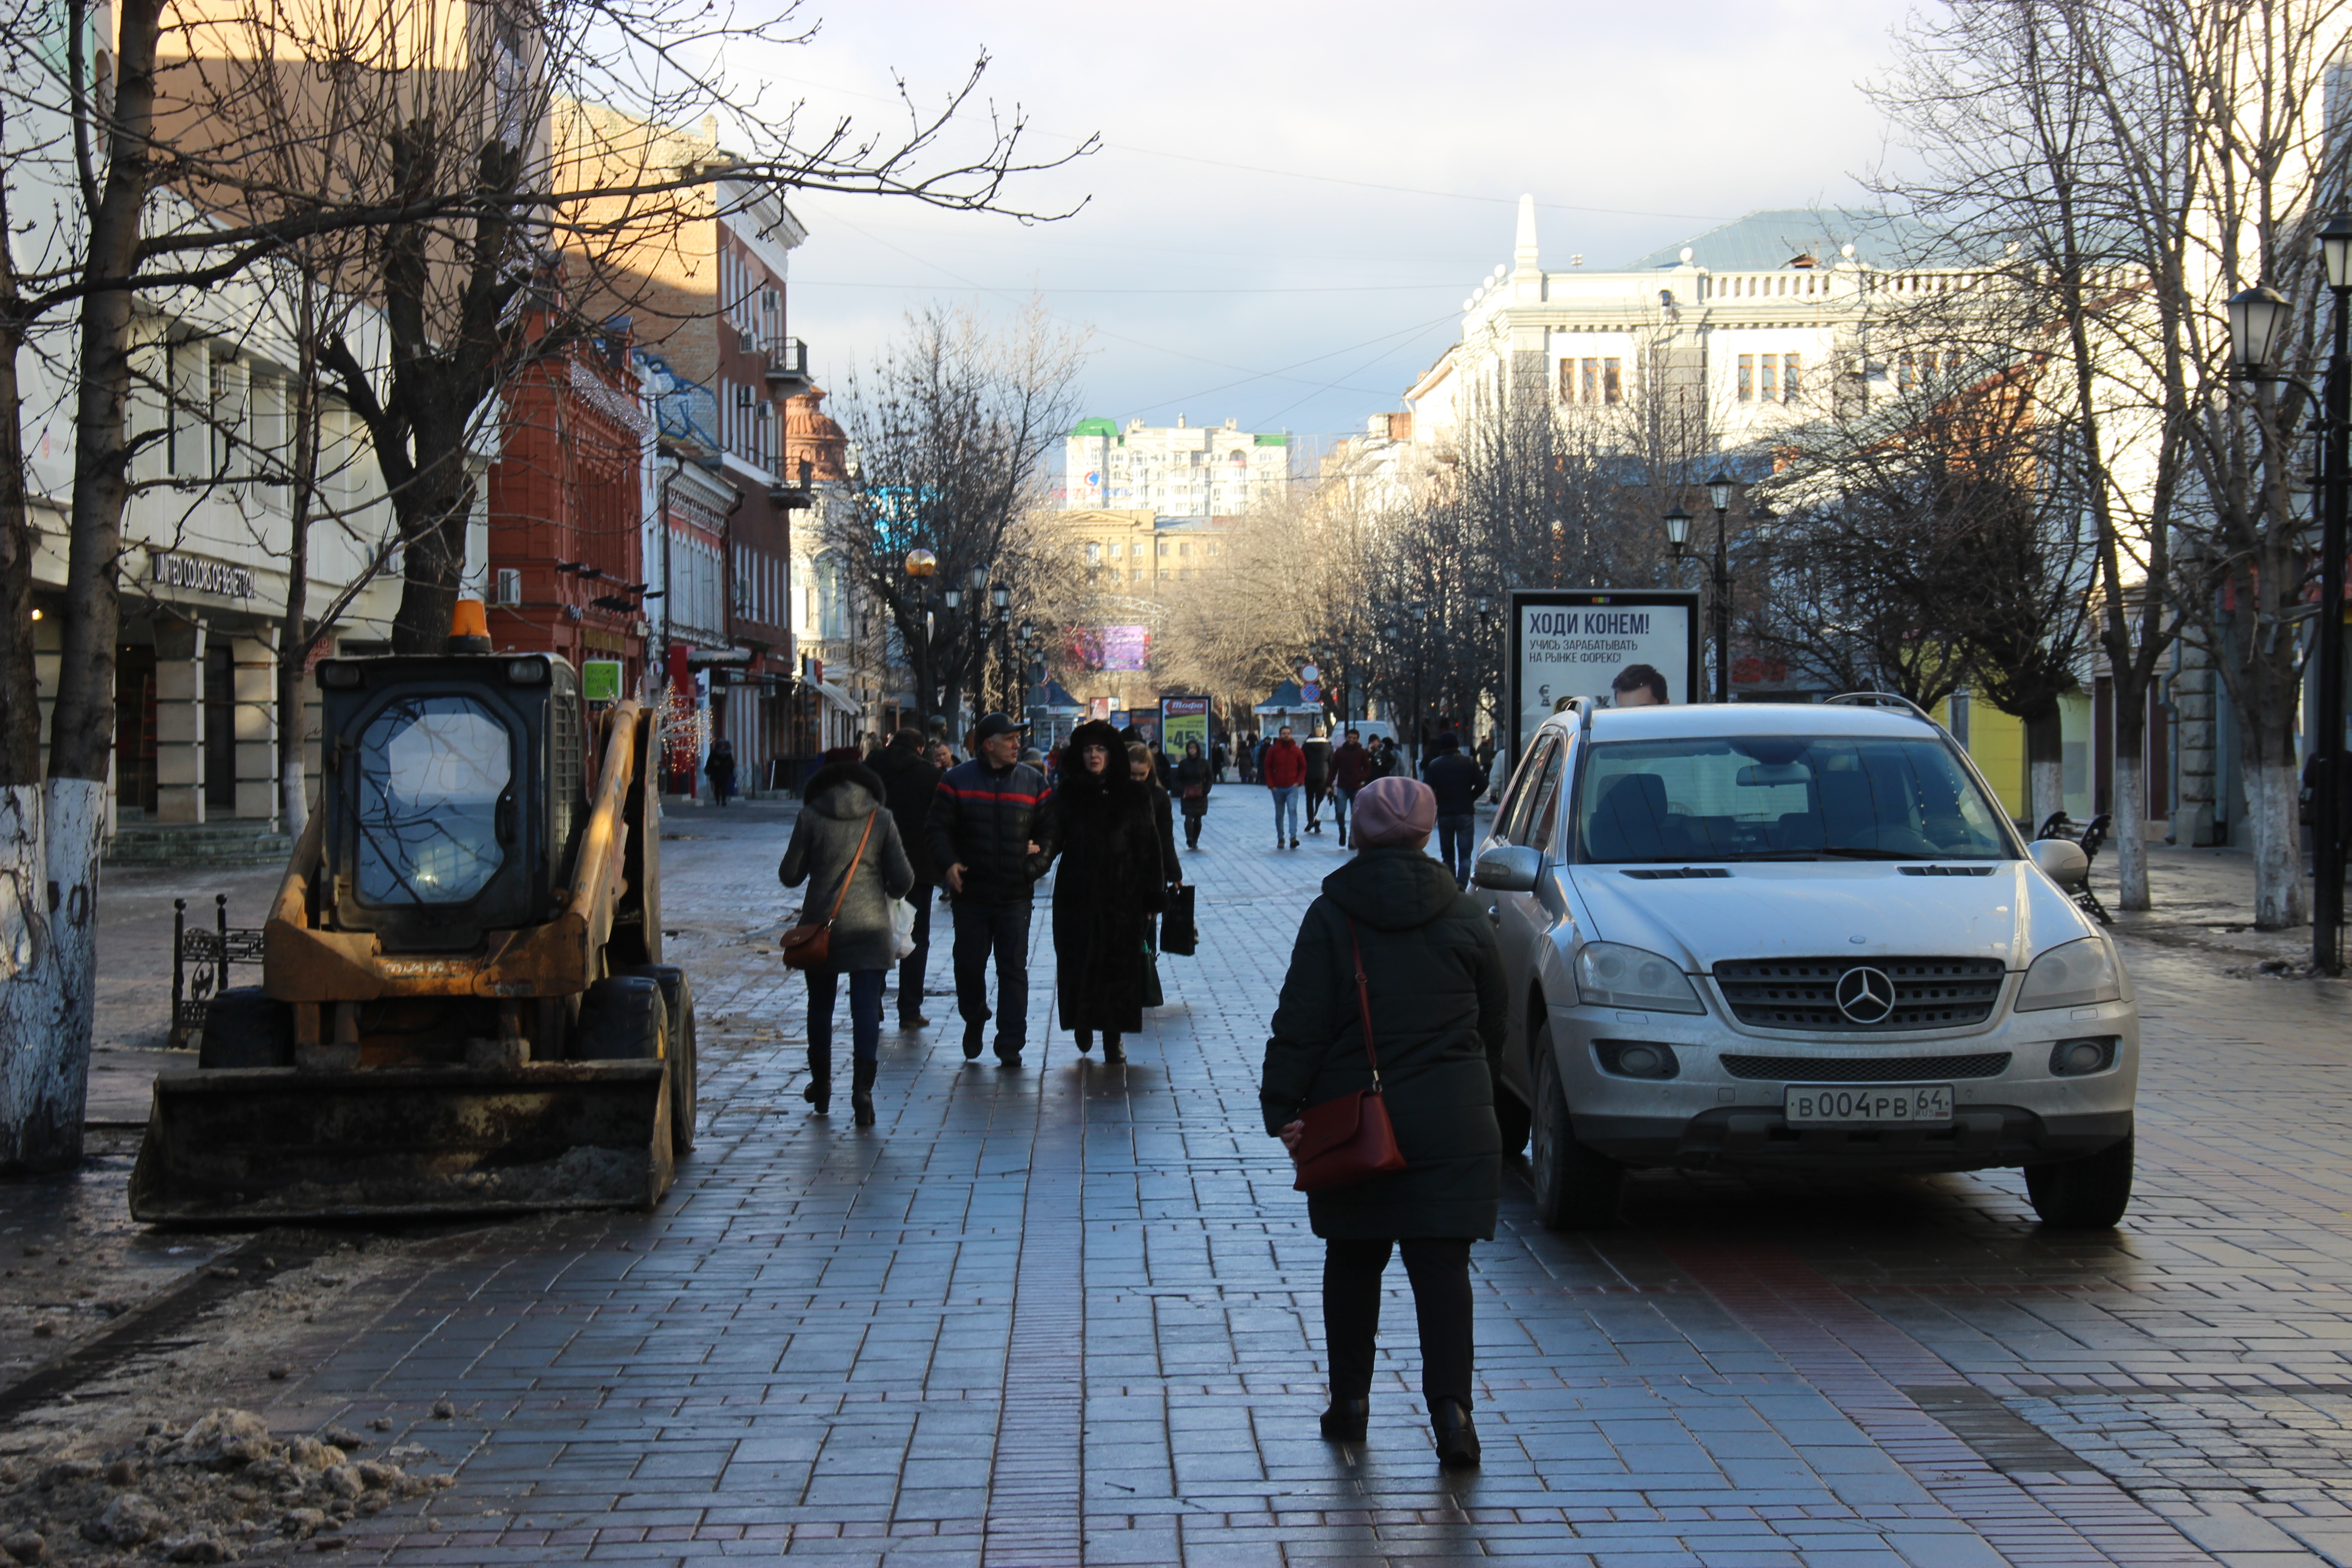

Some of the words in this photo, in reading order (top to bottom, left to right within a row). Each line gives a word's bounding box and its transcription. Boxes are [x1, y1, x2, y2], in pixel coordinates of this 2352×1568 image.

[157, 553, 183, 586] UNITED
[184, 558, 212, 591] COLORS
[212, 563, 222, 592] OF
[1529, 613, 1578, 636] ХОДИ
[1584, 613, 1649, 634] КОНЕМ!
[1529, 639, 1560, 651] УЧИСЬ
[1563, 639, 1638, 651] ЗАРАБАТЫВАТЬ
[1529, 652, 1542, 663] НА
[1545, 652, 1577, 663] РЫНКЕ
[1580, 652, 1621, 663] ФОРЕКС!
